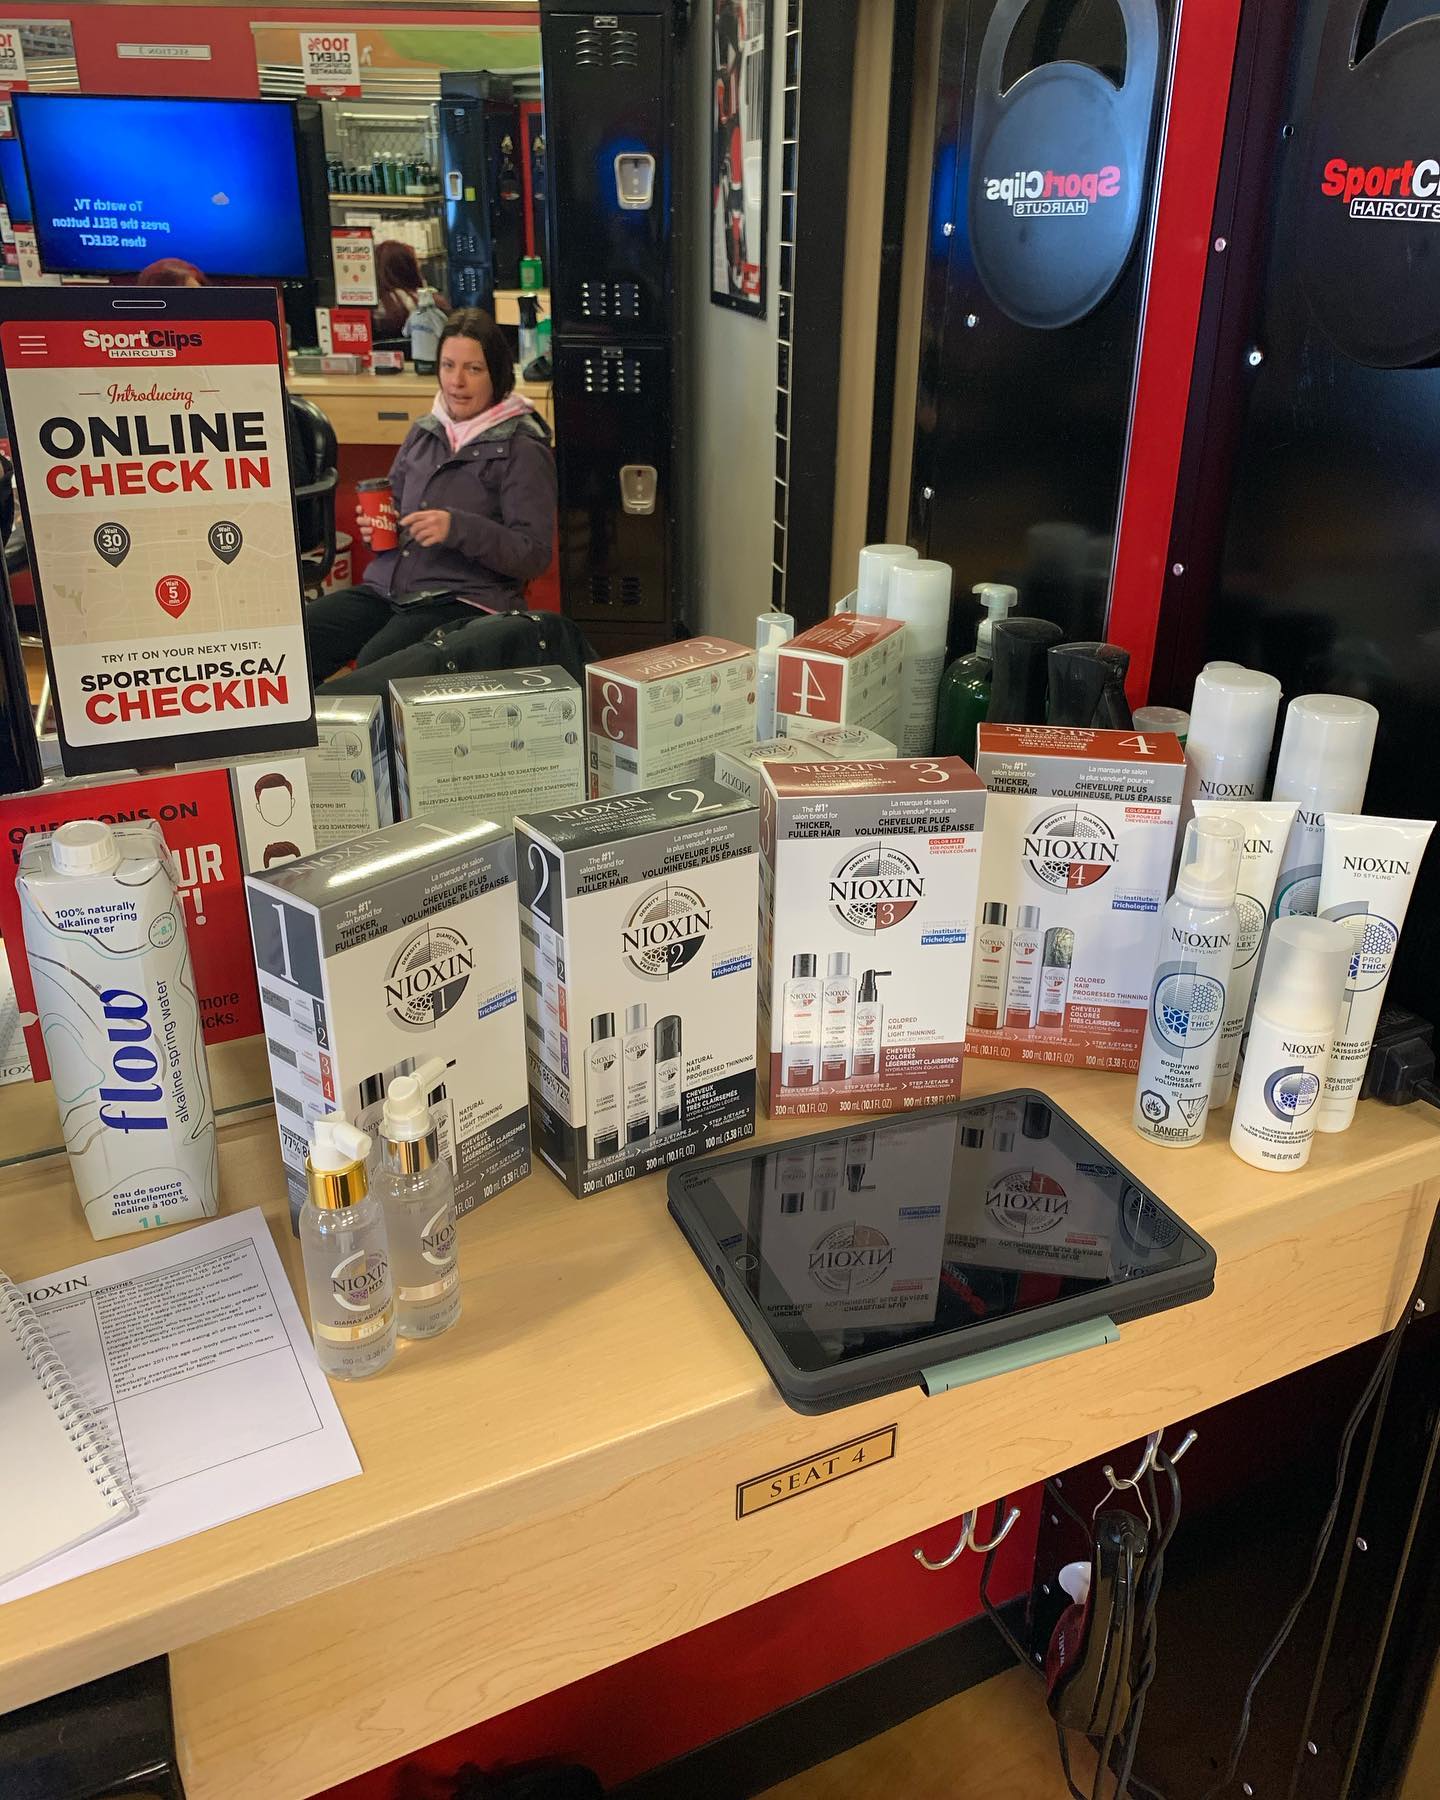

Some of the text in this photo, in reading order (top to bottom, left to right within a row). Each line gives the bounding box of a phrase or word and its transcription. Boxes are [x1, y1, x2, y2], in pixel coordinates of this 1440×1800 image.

[1321, 158, 1440, 203] SportC
[1353, 202, 1440, 218] HAIRCUTS
[82, 329, 202, 350] SportClips
[110, 350, 175, 358] HAIRCUTS
[106, 383, 194, 410] Introducing
[39, 412, 268, 460] ONLINE
[46, 456, 271, 498] CHECK IN
[102, 535, 122, 548] 30
[217, 533, 235, 546] 10
[169, 587, 178, 599] 5
[102, 641, 261, 664] TRY IT ON YOUR NEXT VISIT:
[80, 654, 286, 692] SPORTCLIPS.CA/
[86, 676, 289, 725] CHECKIN
[1006, 727, 1099, 737] NIOXIN
[1118, 736, 1157, 754] 4
[792, 762, 889, 773] NIOXIN
[910, 762, 949, 783] 3
[1200, 781, 1254, 796] NIOXIN
[550, 797, 649, 823] NIOXIN
[668, 789, 722, 813] 2
[160, 802, 199, 820] ON
[889, 809, 901, 817] plus
[929, 807, 942, 815] pour
[762, 788, 771, 855] 3
[795, 822, 832, 830] THICKER,
[855, 827, 916, 836] VOLUMINEUSE,
[941, 823, 974, 832] ÉPAISSE
[878, 816, 950, 826] CHEVELURE PLUS
[788, 829, 840, 838] FULLER HAIR
[286, 836, 390, 875] NIOXIN
[1023, 838, 1119, 862] NIOXIN
[849, 854, 871, 871] DENSITY
[887, 853, 911, 871] DIAMETER
[1343, 857, 1410, 875] NIOXIN
[528, 843, 550, 924] 2
[583, 870, 620, 884] THICKER,
[1071, 865, 1085, 886] 4
[577, 876, 628, 894] FULLER HAIR
[829, 877, 926, 901] NIOXIN
[55, 902, 136, 918] 100% naturally
[881, 904, 895, 925] 3
[58, 912, 137, 928] alkaline spring
[84, 925, 115, 935] water
[621, 910, 713, 954] NIOXIN
[1172, 928, 1231, 947] NIOXIN
[272, 904, 299, 985] 1
[921, 936, 965, 944] Trichologists
[670, 943, 684, 967] 2
[384, 948, 476, 1007] NIOXIN
[201, 992, 239, 1009] more
[438, 989, 448, 1012] 1
[202, 1013, 239, 1029] icks.
[157, 980, 188, 1122] alkaline spring water
[1282, 1042, 1325, 1054] NIOXIN
[99, 989, 168, 1134] flow
[885, 1058, 923, 1067] LÉGÈREMENT
[1161, 1060, 1199, 1070] BODIFYING
[1155, 1077, 1202, 1088] VOLUMISANTE
[1164, 1075, 1193, 1083] MOUSSE
[1153, 1124, 1188, 1137] DANGER
[113, 1181, 182, 1200] eau de source
[114, 1189, 182, 1207] naturellement
[112, 1204, 149, 1216] alcaline
[152, 1201, 158, 1209] à
[161, 1198, 177, 1207] 100
[139, 1215, 168, 1228] 1 L
[332, 1256, 388, 1294] NIOXIN
[17, 1276, 88, 1305] IOXIN
[95, 1281, 133, 1295] ACTIVITIES
[770, 1448, 865, 1498] SEAT 4
